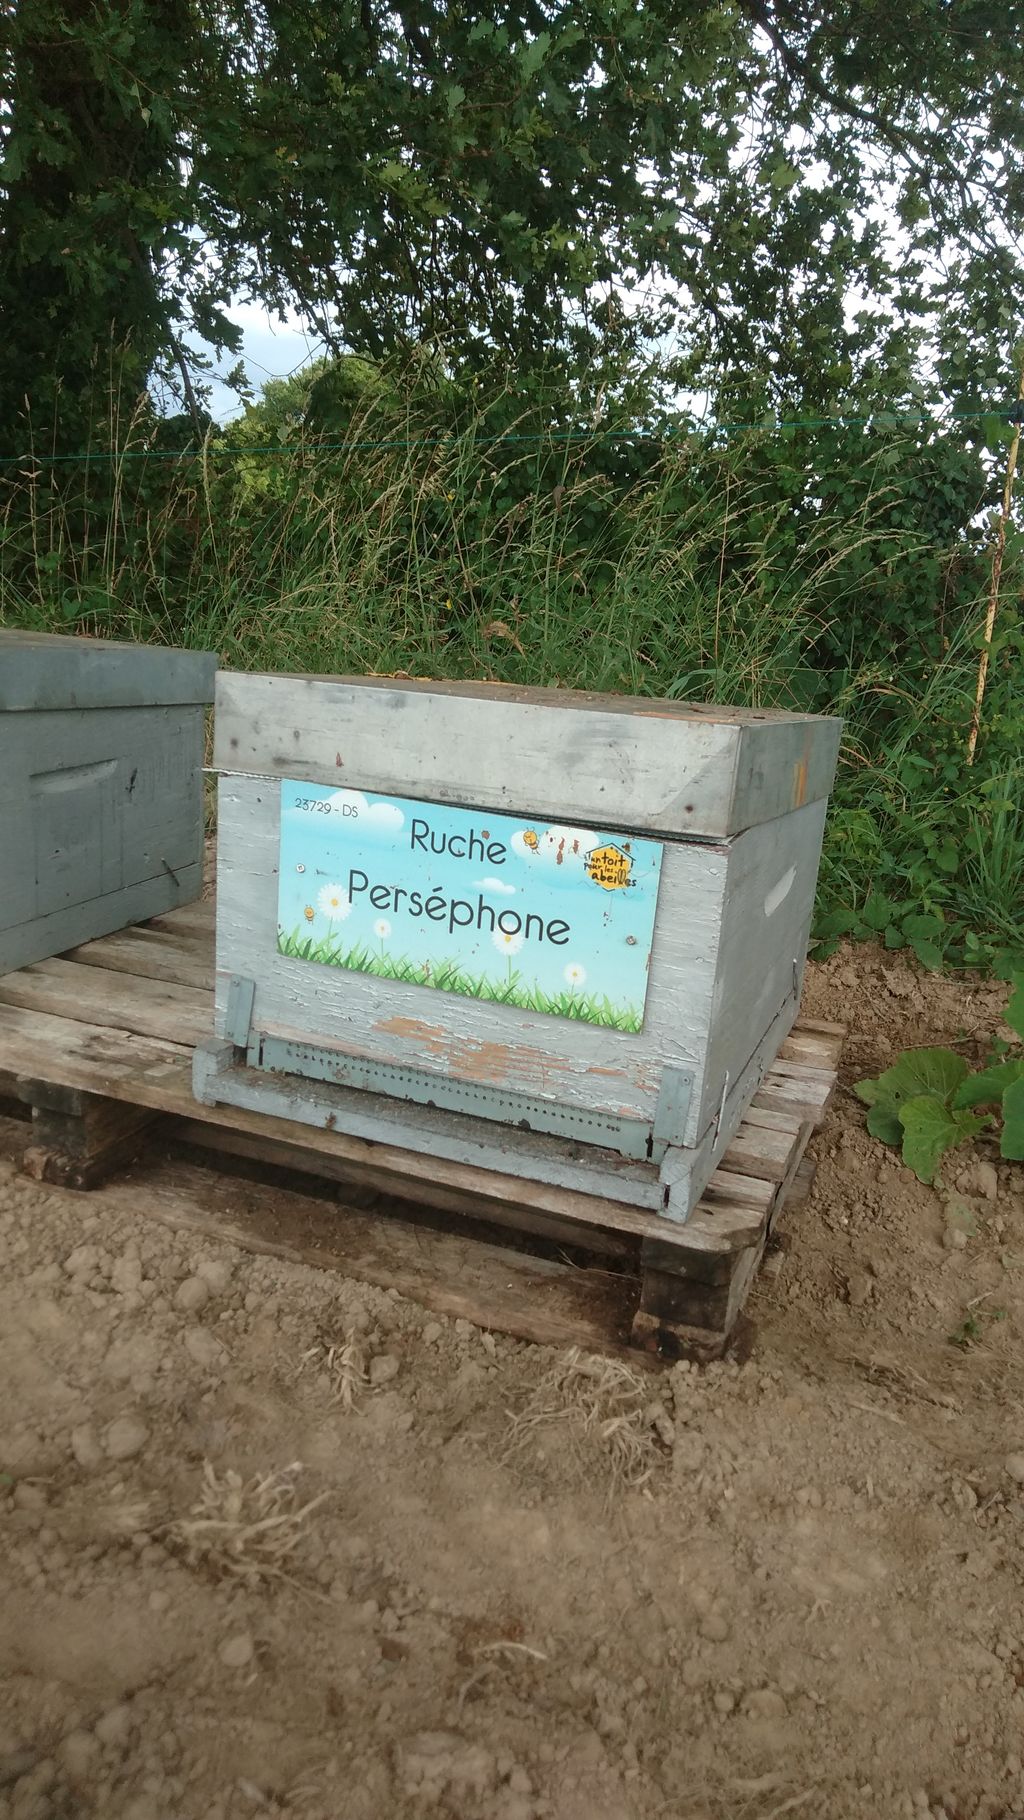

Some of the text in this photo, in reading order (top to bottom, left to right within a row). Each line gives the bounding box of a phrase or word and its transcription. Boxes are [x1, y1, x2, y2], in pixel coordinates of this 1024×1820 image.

[295, 797, 332, 815] 23729
[342, 804, 359, 818] DS
[411, 818, 507, 865] Ruche
[583, 862, 614, 873] pour les
[602, 852, 626, 867] toit
[591, 869, 637, 887] abeilles
[348, 868, 571, 946] Perséphone
